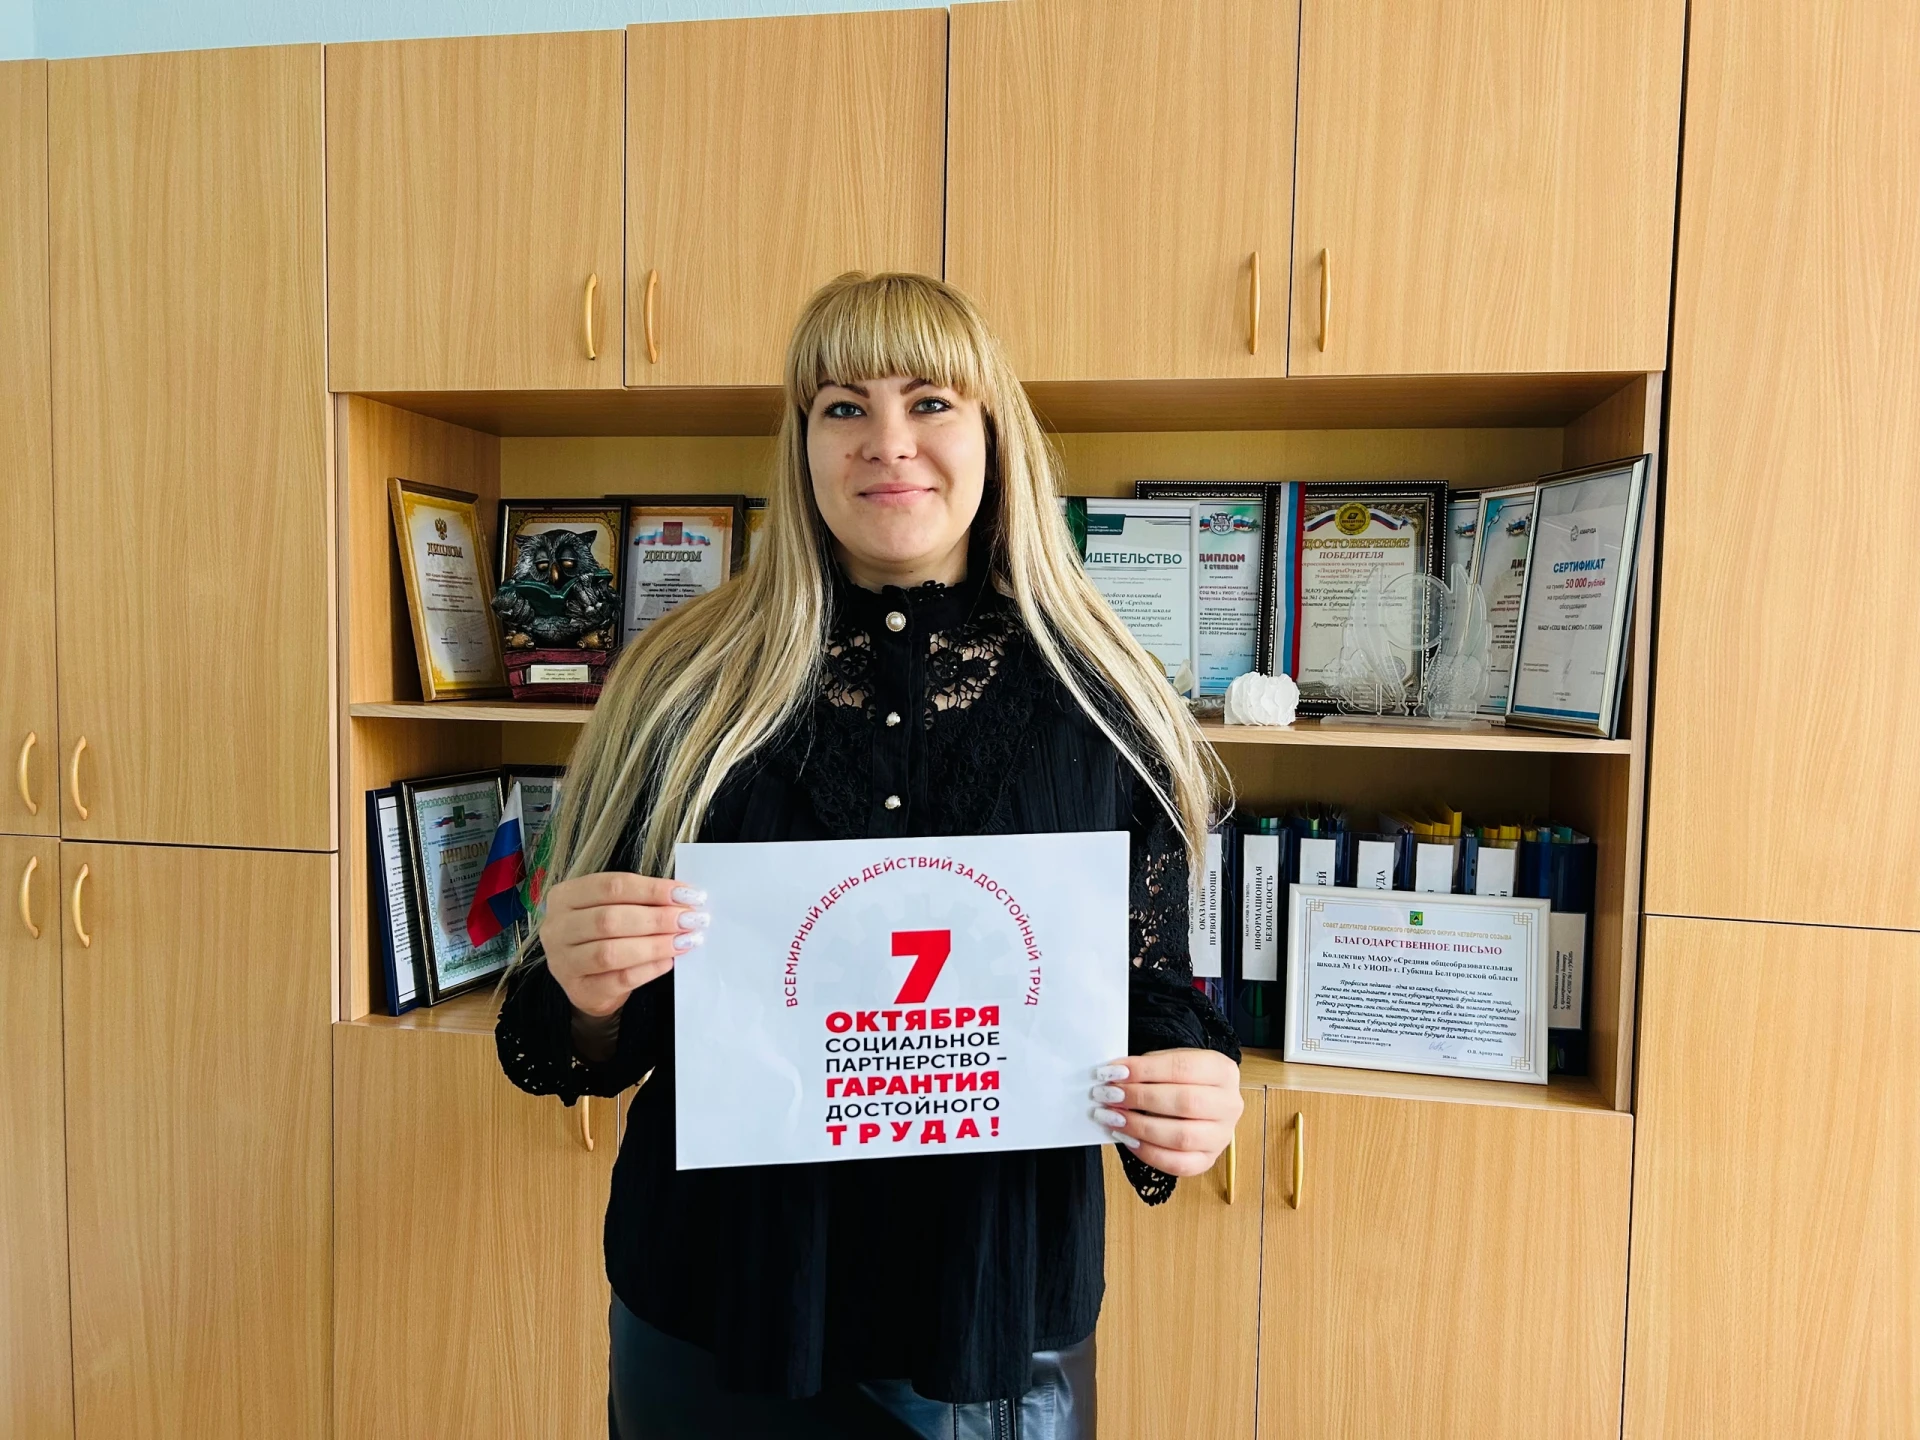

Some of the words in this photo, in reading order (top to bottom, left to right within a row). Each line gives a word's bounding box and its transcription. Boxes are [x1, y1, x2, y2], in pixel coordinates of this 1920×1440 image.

[1303, 538, 1410, 550] ДОСТОВЕРЕНИЕ
[643, 550, 702, 563] ДИПЛОМ
[1085, 553, 1182, 564] ИДЕТЕЛЬСТВО
[1199, 554, 1245, 562] ДИПЛОМ
[1319, 552, 1384, 560] ПОБЕДИТЕЛЯ
[1553, 558, 1605, 573] СЕРТИФИКАТ
[1565, 579, 1573, 588] 50
[1575, 578, 1587, 588] 000
[1588, 578, 1606, 588] рублей
[784, 905, 825, 1008] ВСЕМИРНЫЙ
[821, 876, 861, 910] ДЕНЬ
[862, 856, 953, 882] ДЕЙСТВИЙ
[954, 862, 975, 879] ЗА
[974, 874, 1043, 962] ДОСТОЙНЫЙ
[1024, 968, 1041, 1006] ТРУД
[1368, 925, 1403, 933] ГУБКИНСКОГО
[1404, 927, 1436, 935] ГОРОДСКОГО
[1335, 936, 1450, 951] БЛАГОДАРСТВЕННОЕ
[1453, 944, 1502, 955] ПИСЬМО
[891, 930, 951, 1004] 7
[1322, 952, 1365, 961] Коллективу
[1394, 957, 1429, 965] «Средняя
[1431, 960, 1512, 971] общеобразовательная
[1364, 964, 1392, 972] УИОП»
[1402, 967, 1433, 975] Губкина
[1435, 970, 1486, 979] Белгородской
[825, 1005, 1000, 1034] ОКТЯБРЯ
[825, 1031, 1000, 1055] СОЦИАЛЬНОЕ
[825, 1052, 990, 1073] ПАРТНЕРСТВО
[825, 1071, 1000, 1098] ГАРАНТИЯ
[825, 1096, 1000, 1122] ДОСТОЙНОГО
[825, 1117, 1000, 1146] ТРУДА!
